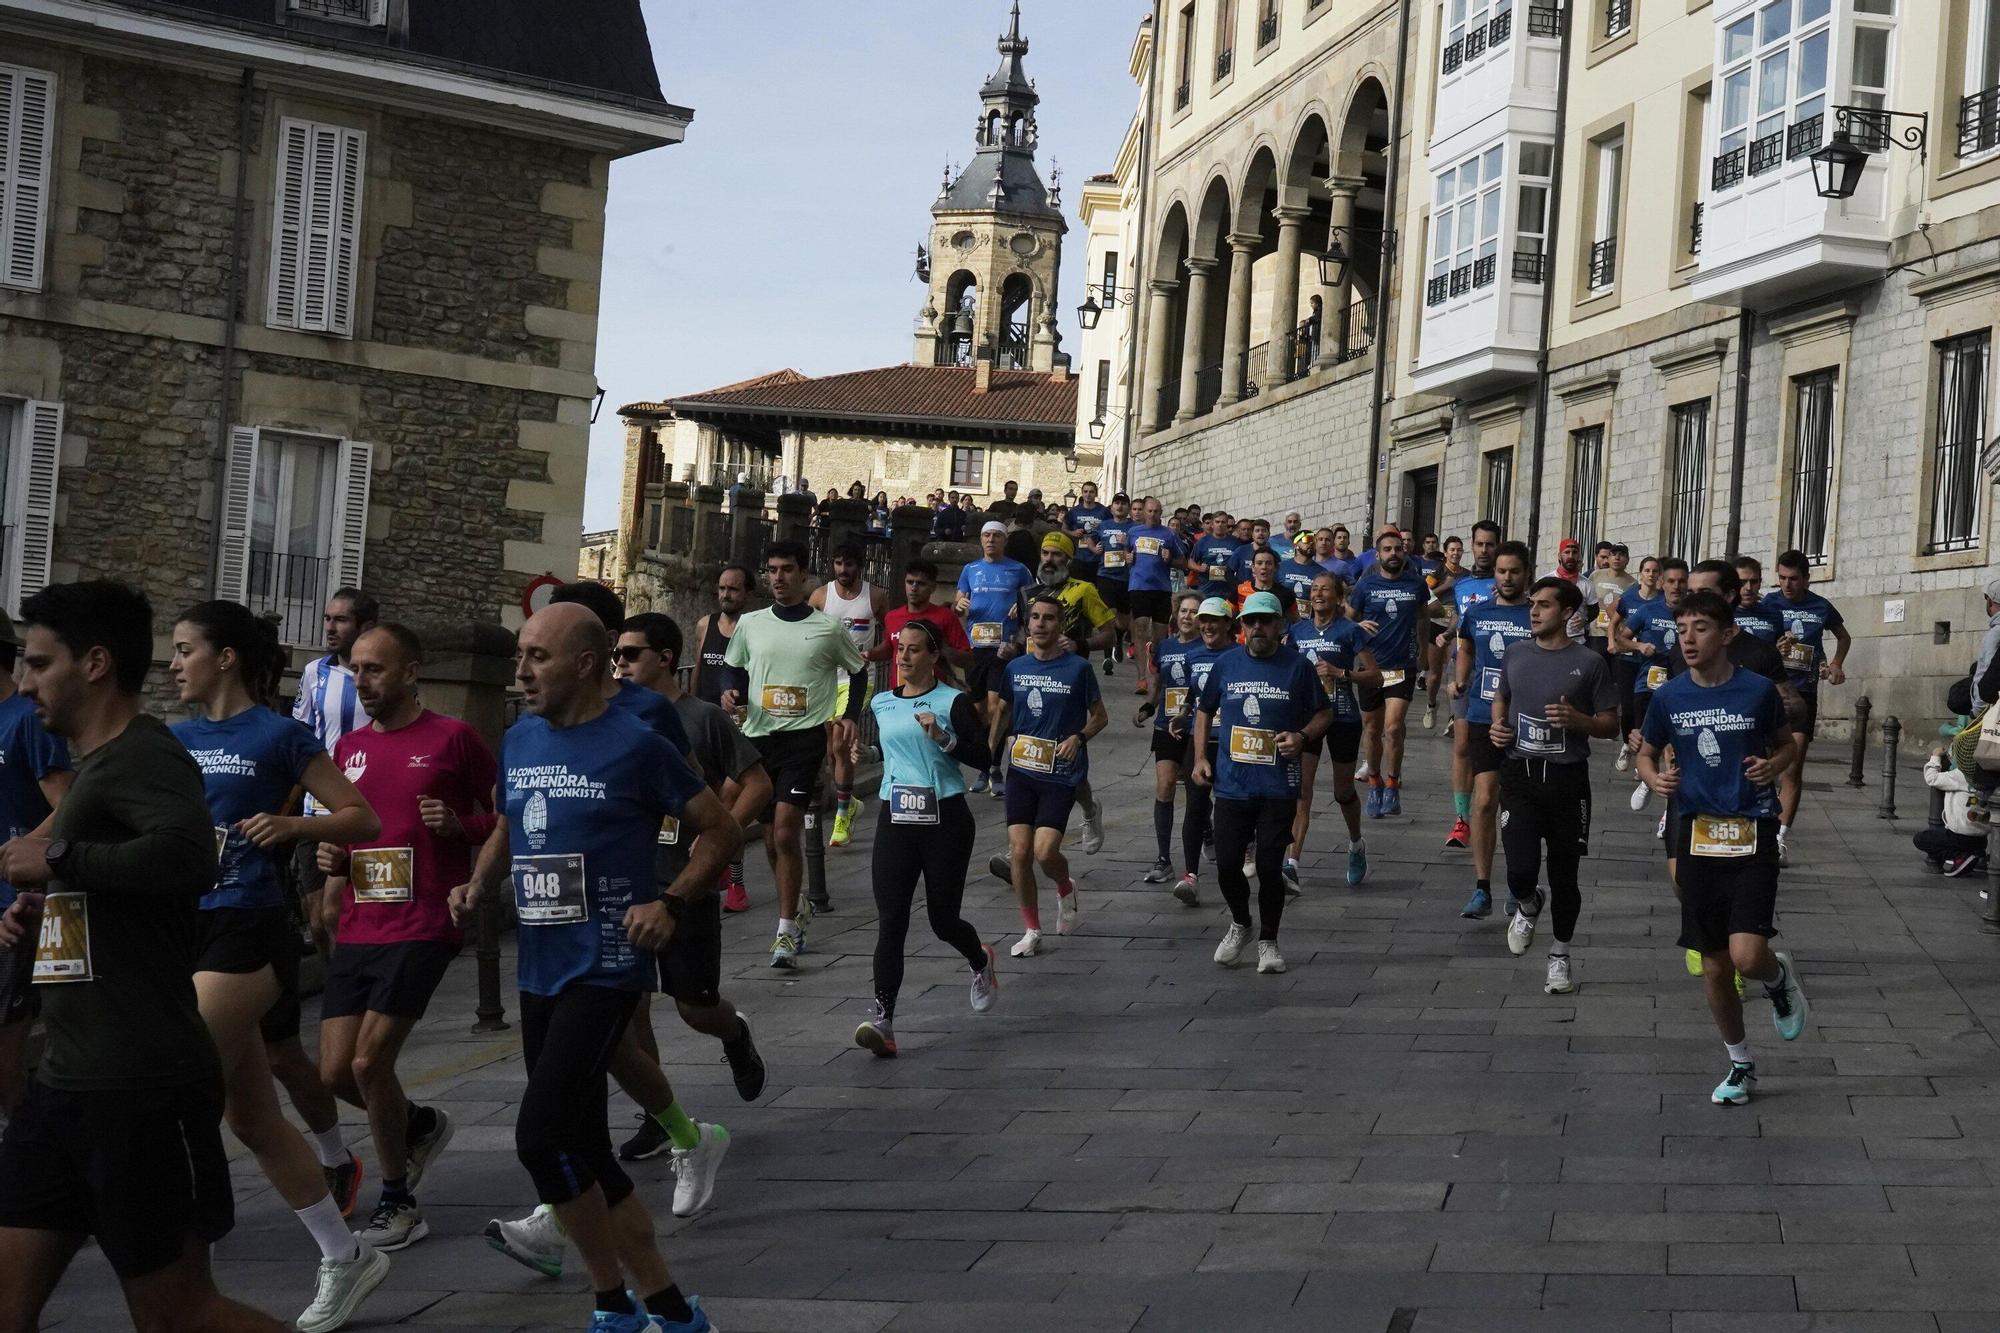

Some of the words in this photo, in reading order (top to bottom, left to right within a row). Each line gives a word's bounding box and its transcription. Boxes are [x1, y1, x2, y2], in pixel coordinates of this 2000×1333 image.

[773, 693, 796, 705] 633
[1679, 708, 1726, 719] CONQUISTA
[1682, 713, 1744, 728] ALMENDRA
[1528, 726, 1550, 740] 981
[1715, 723, 1755, 732] KONKISTA
[1242, 736, 1263, 750] 374
[1023, 744, 1043, 759] 291
[198, 752, 240, 768] ENDRA
[202, 766, 255, 776] KONKISTA
[508, 768, 516, 776] LA
[517, 765, 568, 776] CONQUISTA
[514, 775, 589, 789] ALMENDRA
[549, 788, 606, 799] KONKISTA
[900, 794, 926, 810] 906
[1709, 823, 1740, 840] 355
[365, 862, 392, 883] 521
[523, 873, 560, 898] 948
